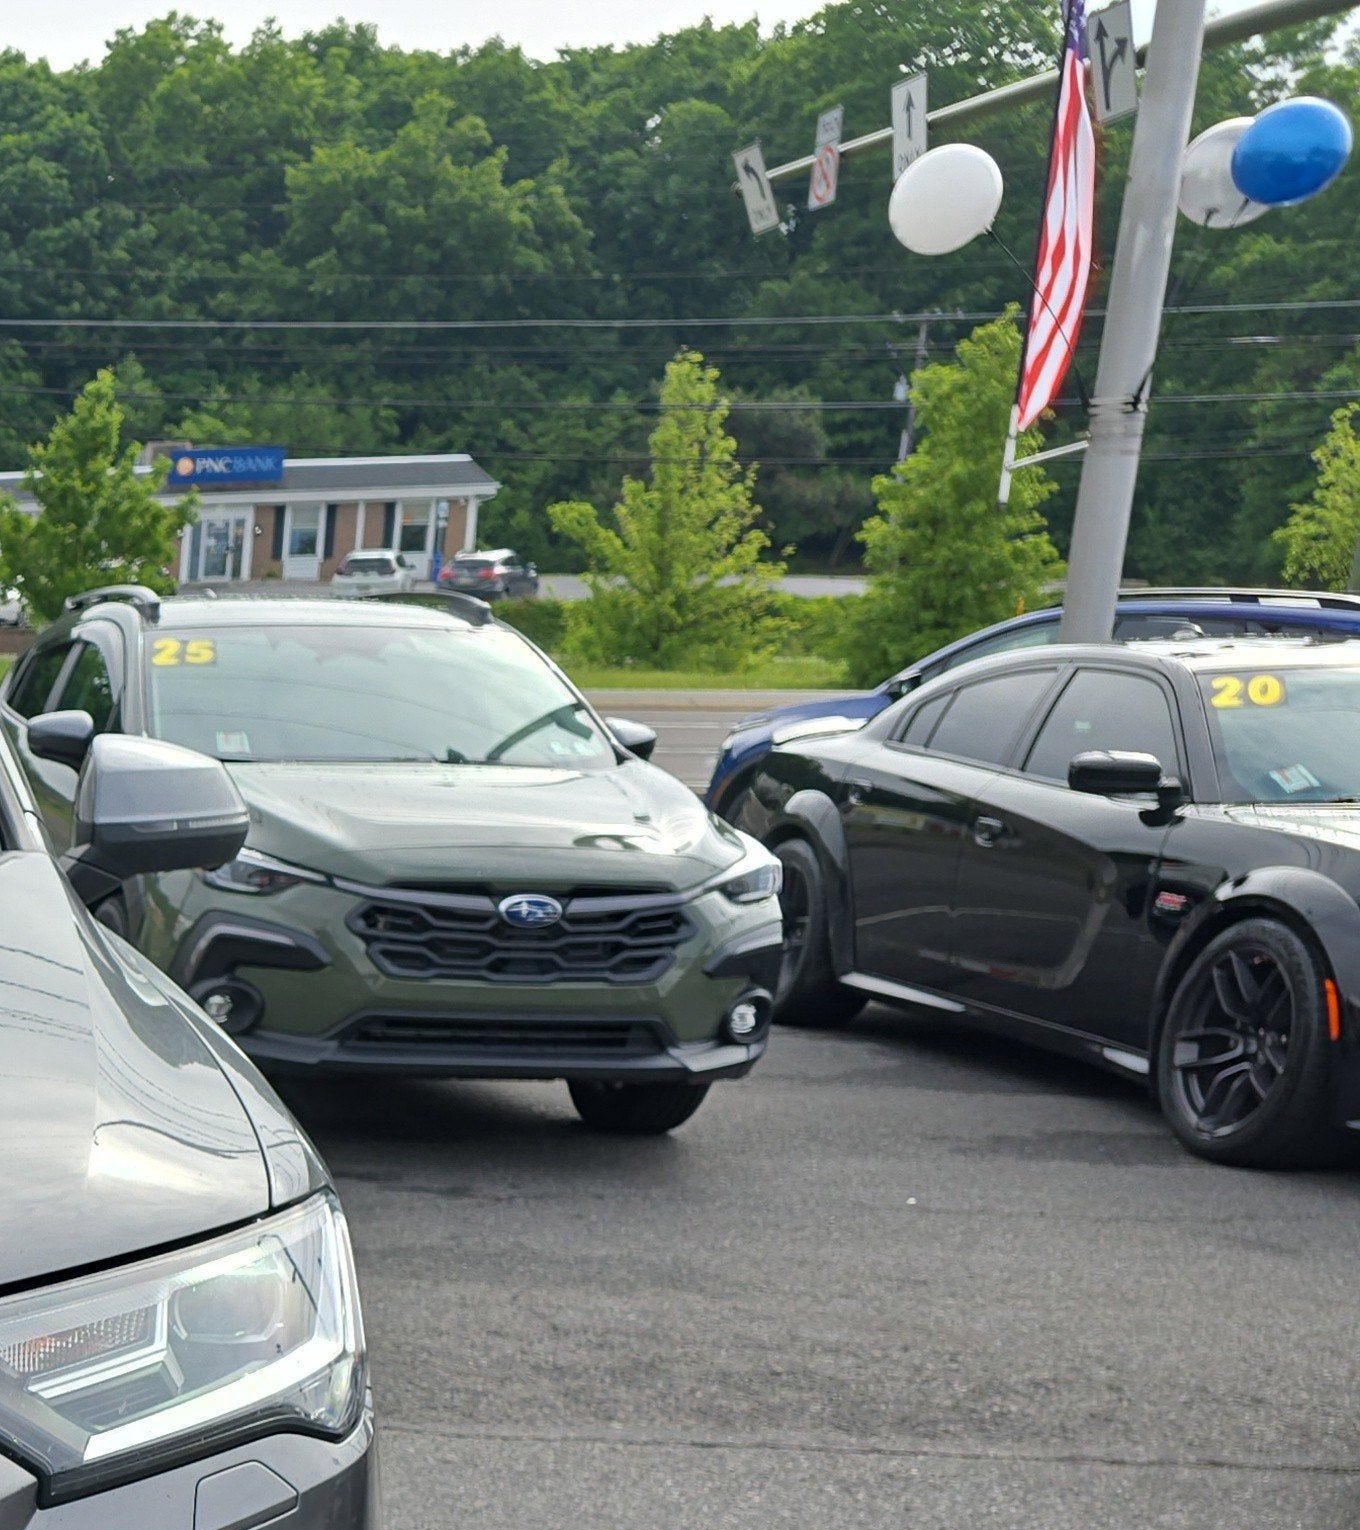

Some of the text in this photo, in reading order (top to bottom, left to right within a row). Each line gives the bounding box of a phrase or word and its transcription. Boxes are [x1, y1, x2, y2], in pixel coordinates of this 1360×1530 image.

[195, 455, 276, 473] PNC BANK
[151, 637, 216, 667] 25
[1211, 674, 1285, 709] 20
